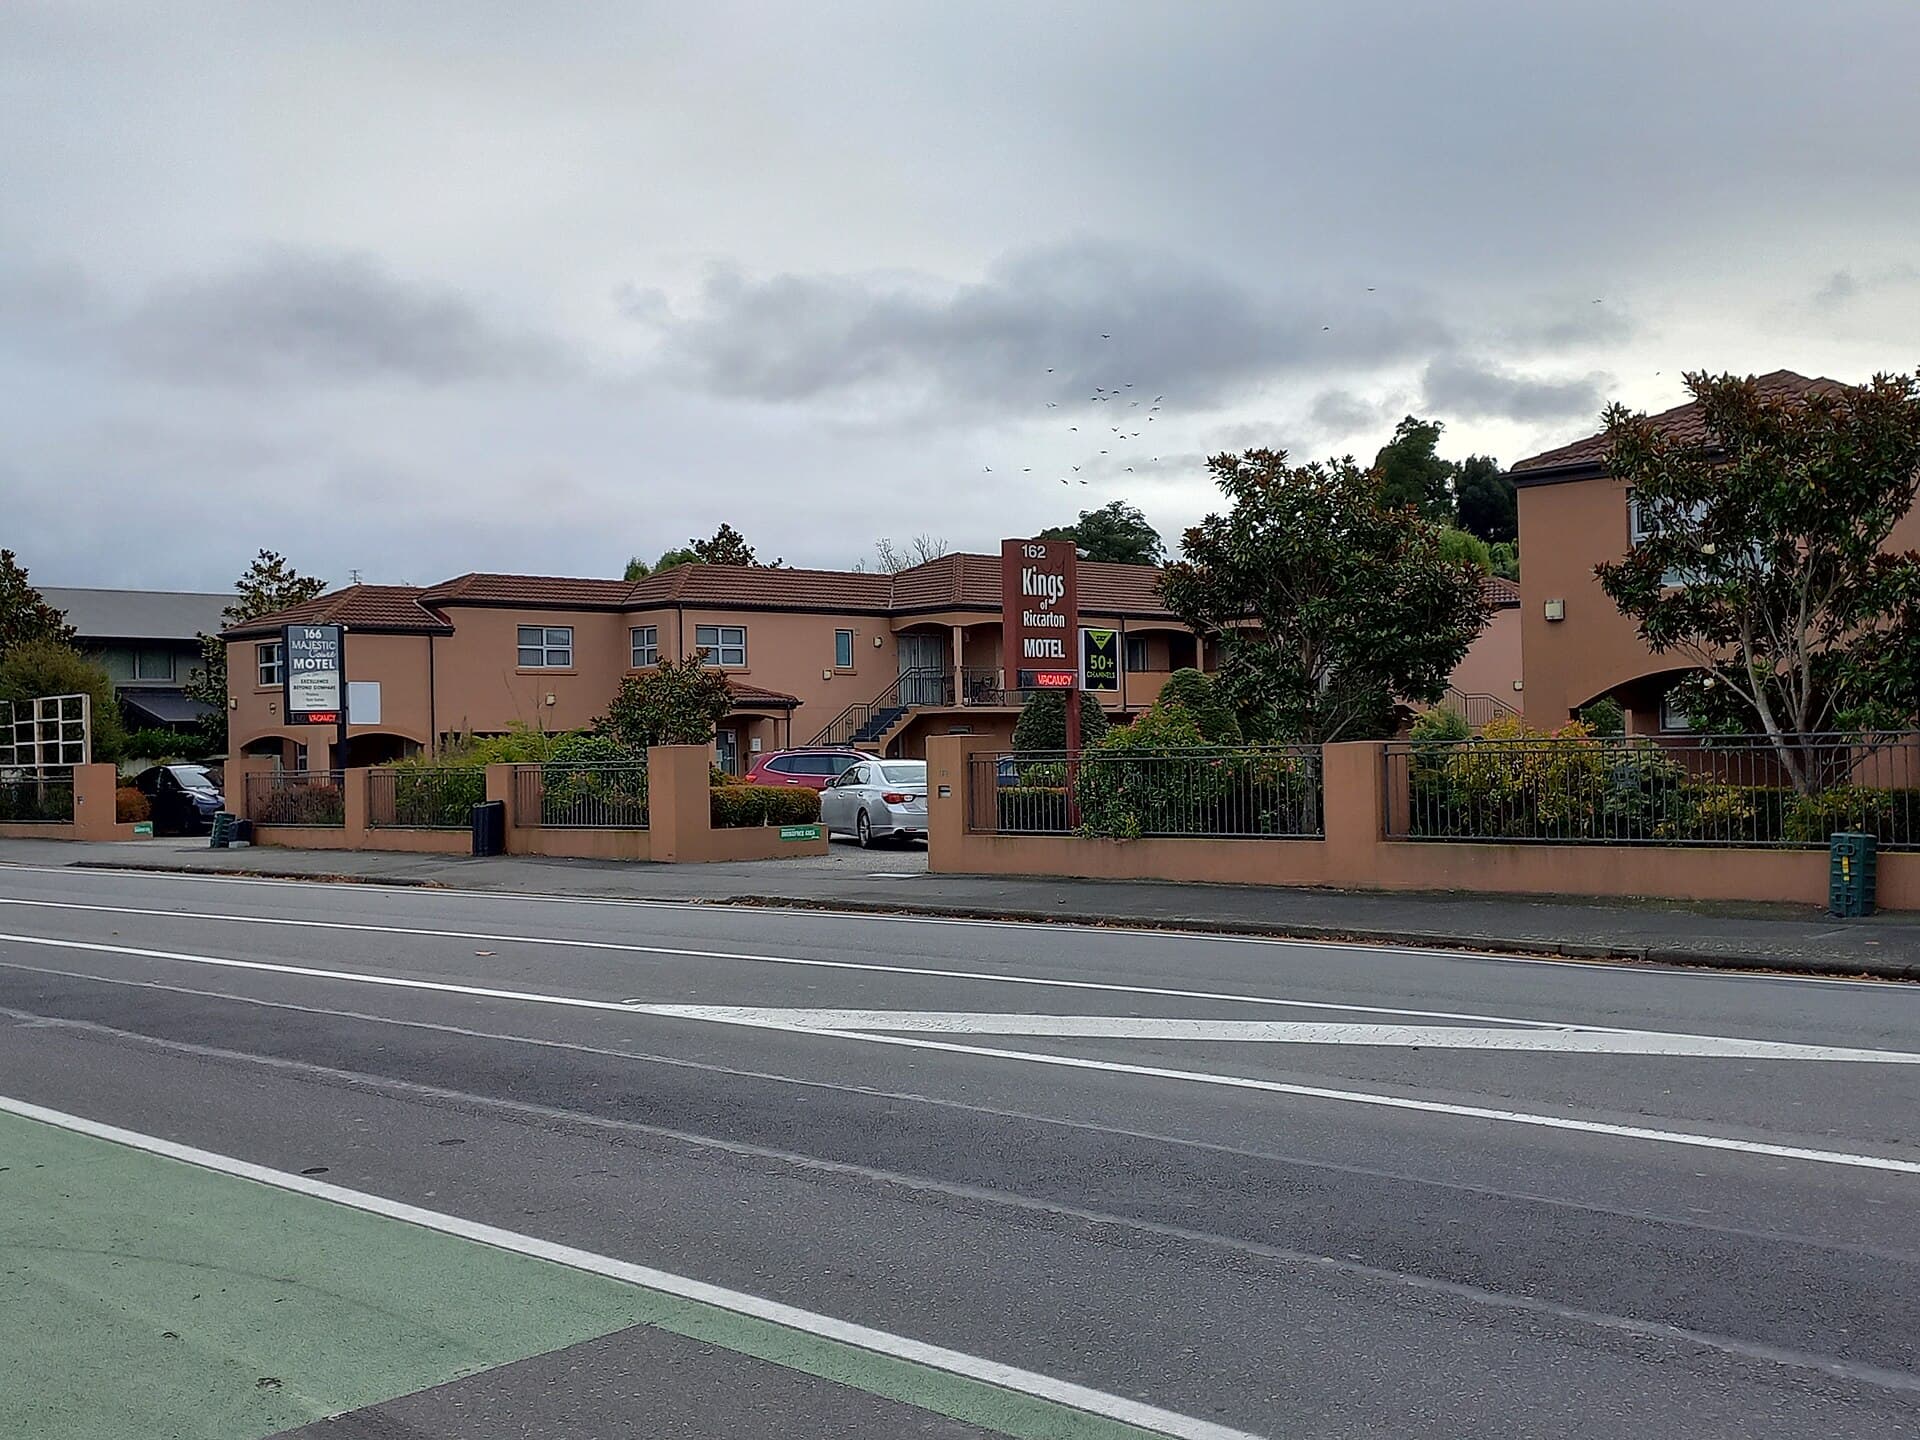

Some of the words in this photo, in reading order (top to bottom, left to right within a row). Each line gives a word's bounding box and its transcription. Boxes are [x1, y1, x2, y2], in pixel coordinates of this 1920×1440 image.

[1021, 544, 1046, 559] 162
[1022, 565, 1065, 605] Kings
[1039, 598, 1048, 610] of
[1023, 610, 1066, 628] Riccarton
[303, 628, 322, 640] 166
[291, 640, 336, 650] MAJESTIC
[1023, 639, 1066, 658] MOTEL
[293, 658, 336, 670] MOTEL
[1090, 654, 1114, 670] 50+
[1037, 674, 1073, 686] VACANCY
[308, 714, 336, 722] VACANCY
